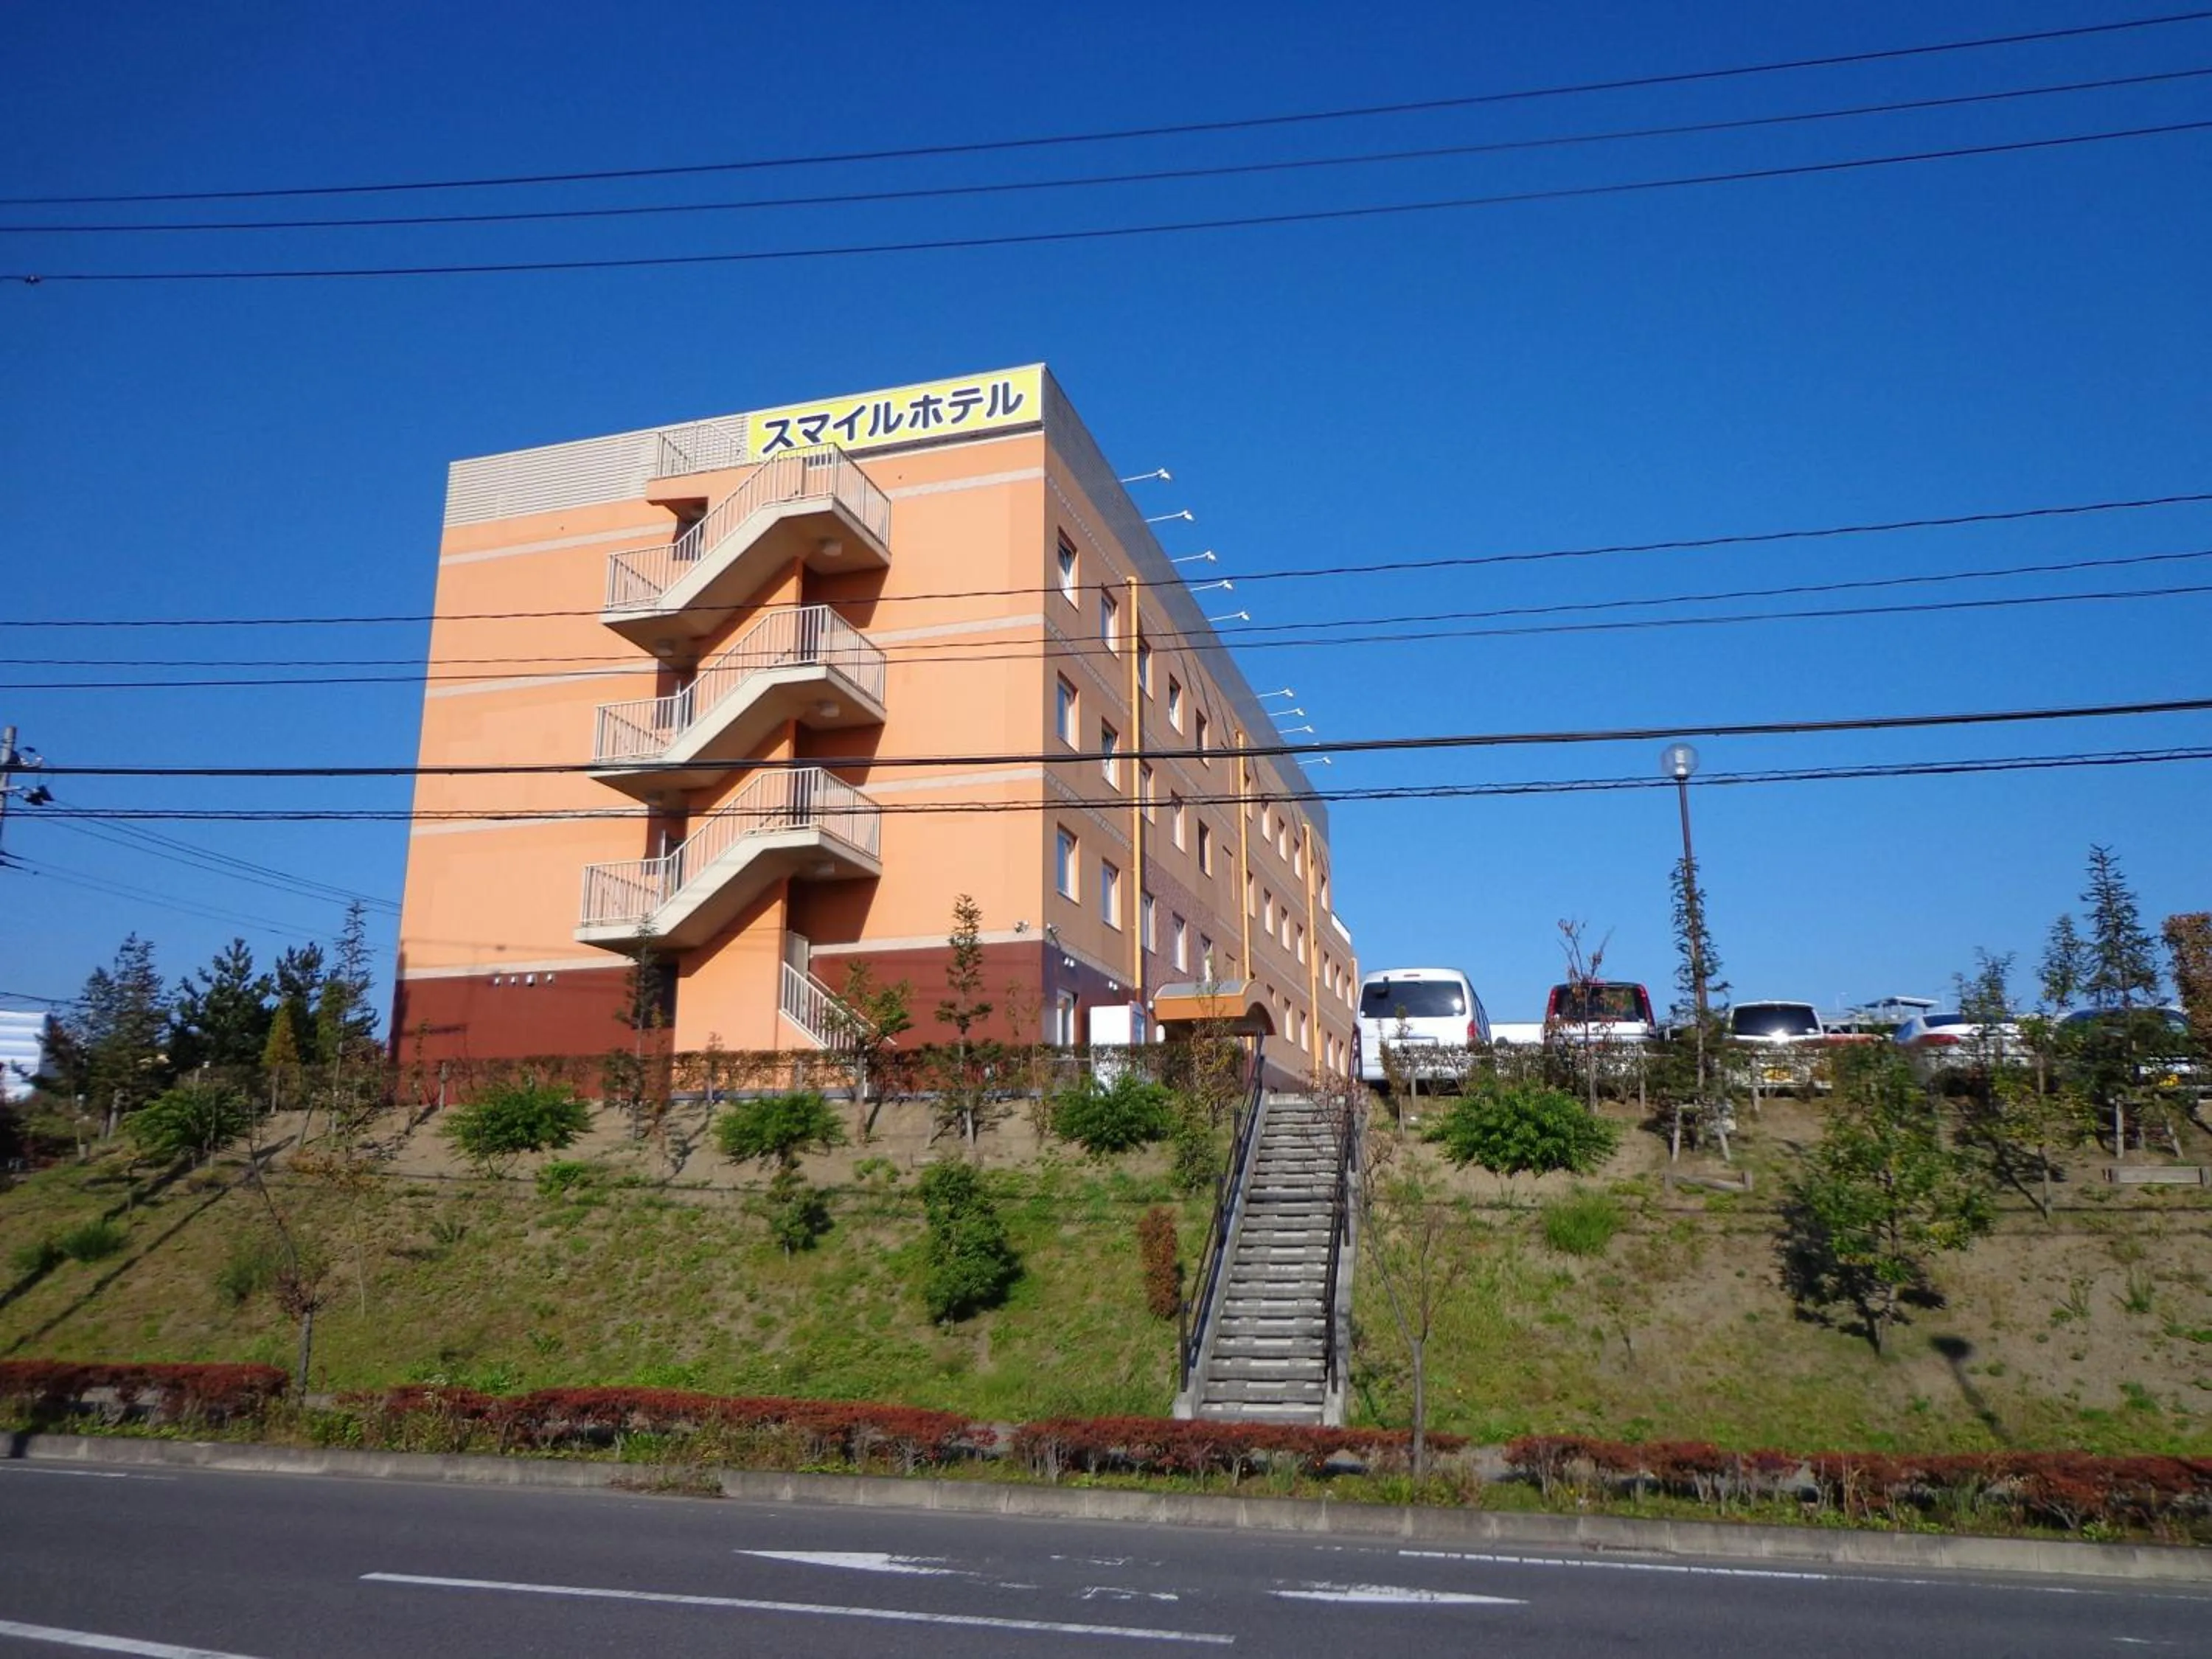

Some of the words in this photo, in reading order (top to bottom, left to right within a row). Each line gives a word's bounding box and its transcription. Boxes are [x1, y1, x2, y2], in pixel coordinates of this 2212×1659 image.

[762, 381, 1024, 454] スマイルホテル
